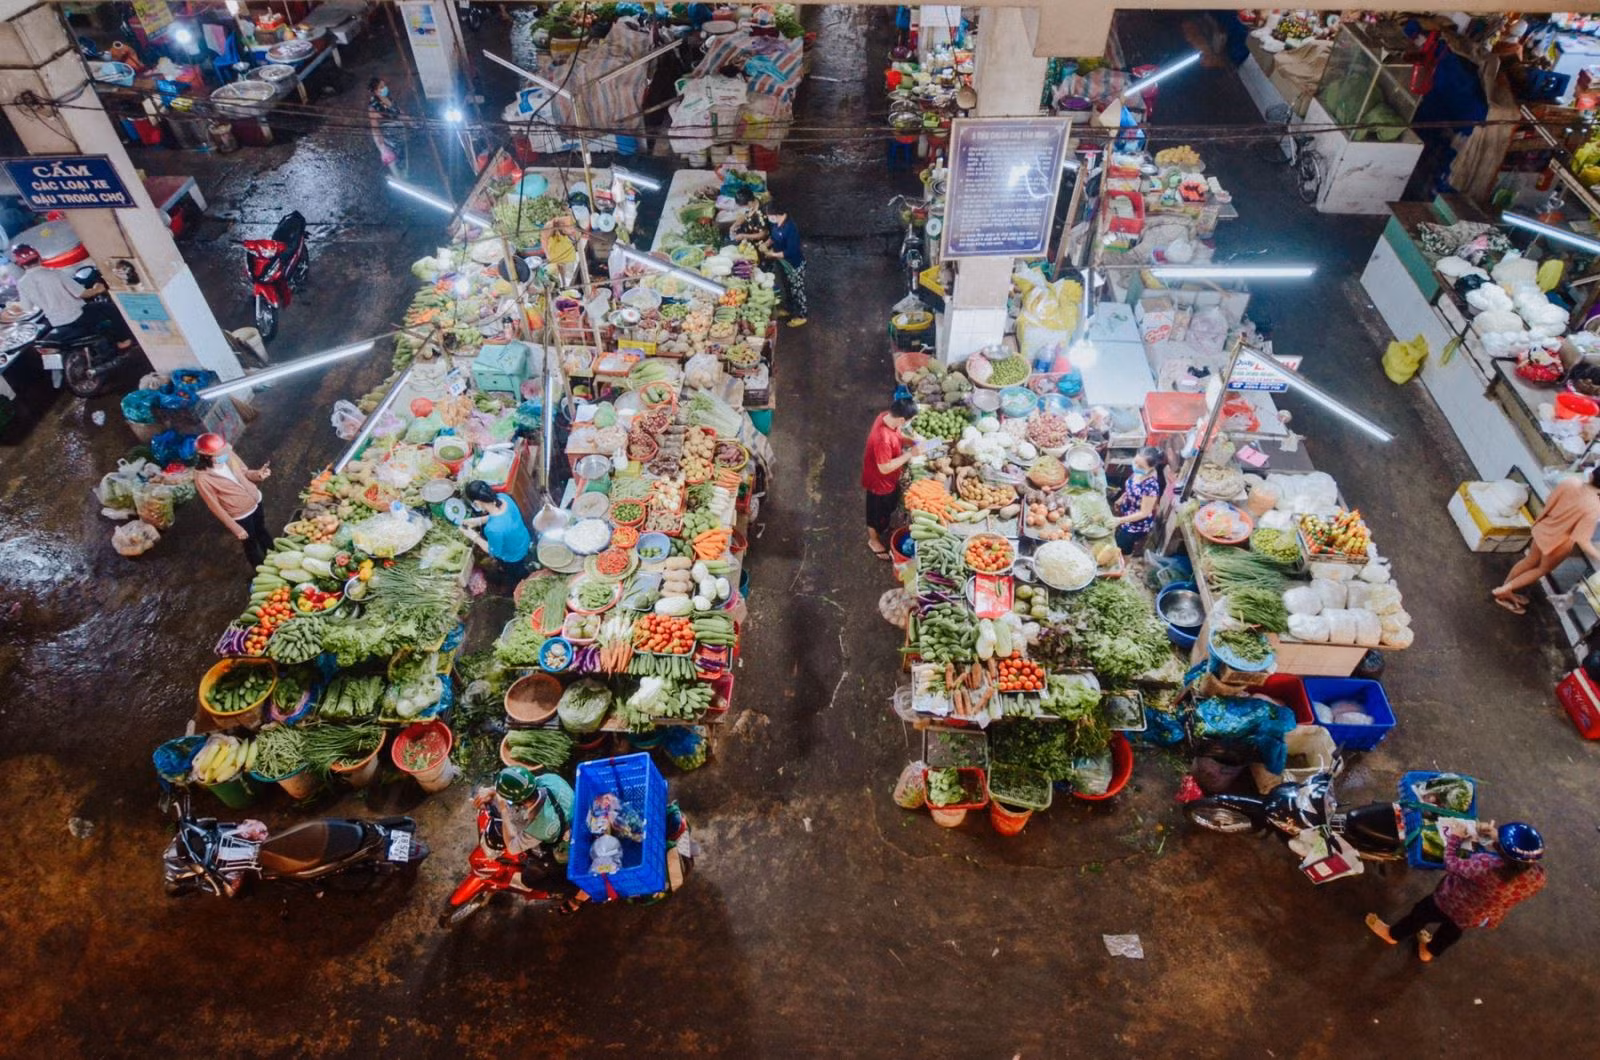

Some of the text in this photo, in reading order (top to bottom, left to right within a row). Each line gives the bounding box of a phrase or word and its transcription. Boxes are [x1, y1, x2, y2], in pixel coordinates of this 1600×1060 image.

[32, 161, 93, 178] CẤM
[31, 179, 111, 192] CÁC LOẠI XE
[31, 192, 125, 206] ĐẬU TRONG CHỢ
